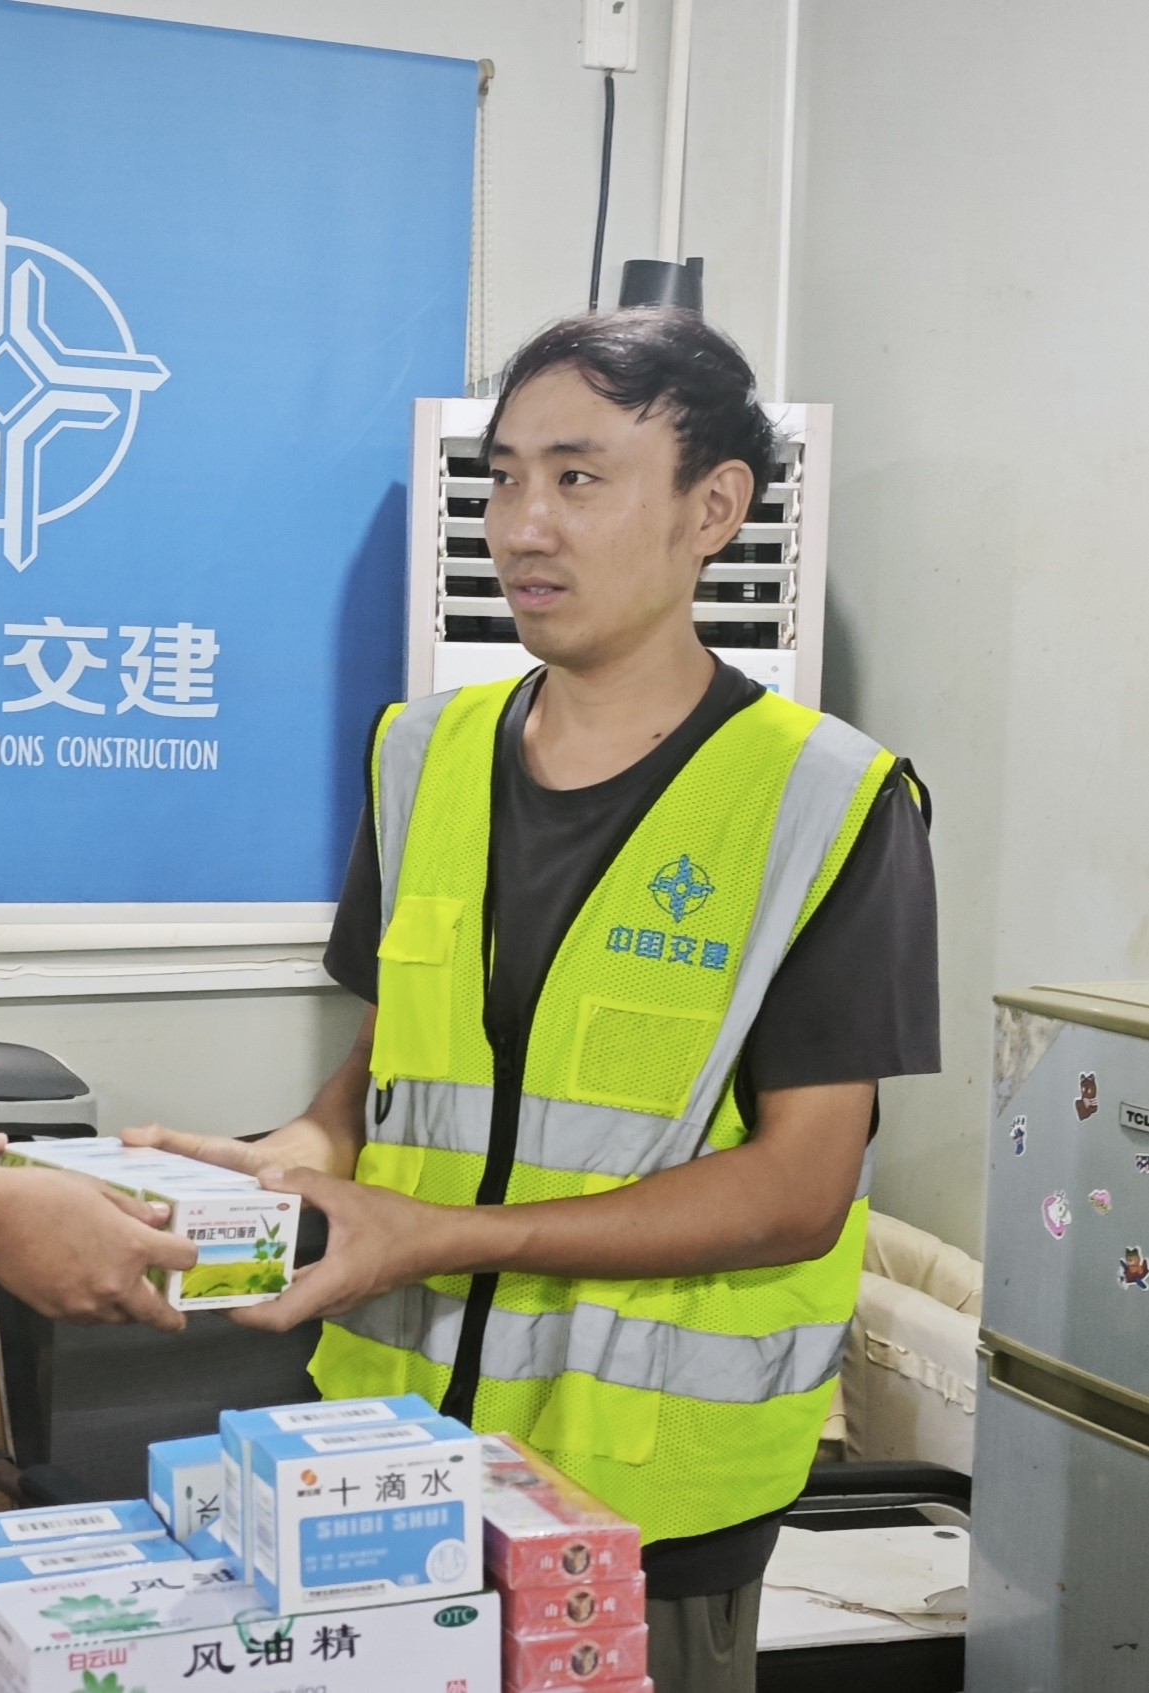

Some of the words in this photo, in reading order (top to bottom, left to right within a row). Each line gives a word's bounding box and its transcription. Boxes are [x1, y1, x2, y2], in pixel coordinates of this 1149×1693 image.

[56, 736, 219, 770] CONSTRUCTION
[605, 925, 729, 970] 中国交建
[1126, 1110, 1149, 1127] TCL
[329, 1468, 453, 1507] 十滴水
[316, 1515, 383, 1540] SHIDI
[392, 1508, 449, 1532] SHUI
[437, 1606, 475, 1626] OTC
[68, 1646, 127, 1671] 白云山
[183, 1624, 361, 1678] 风油精
